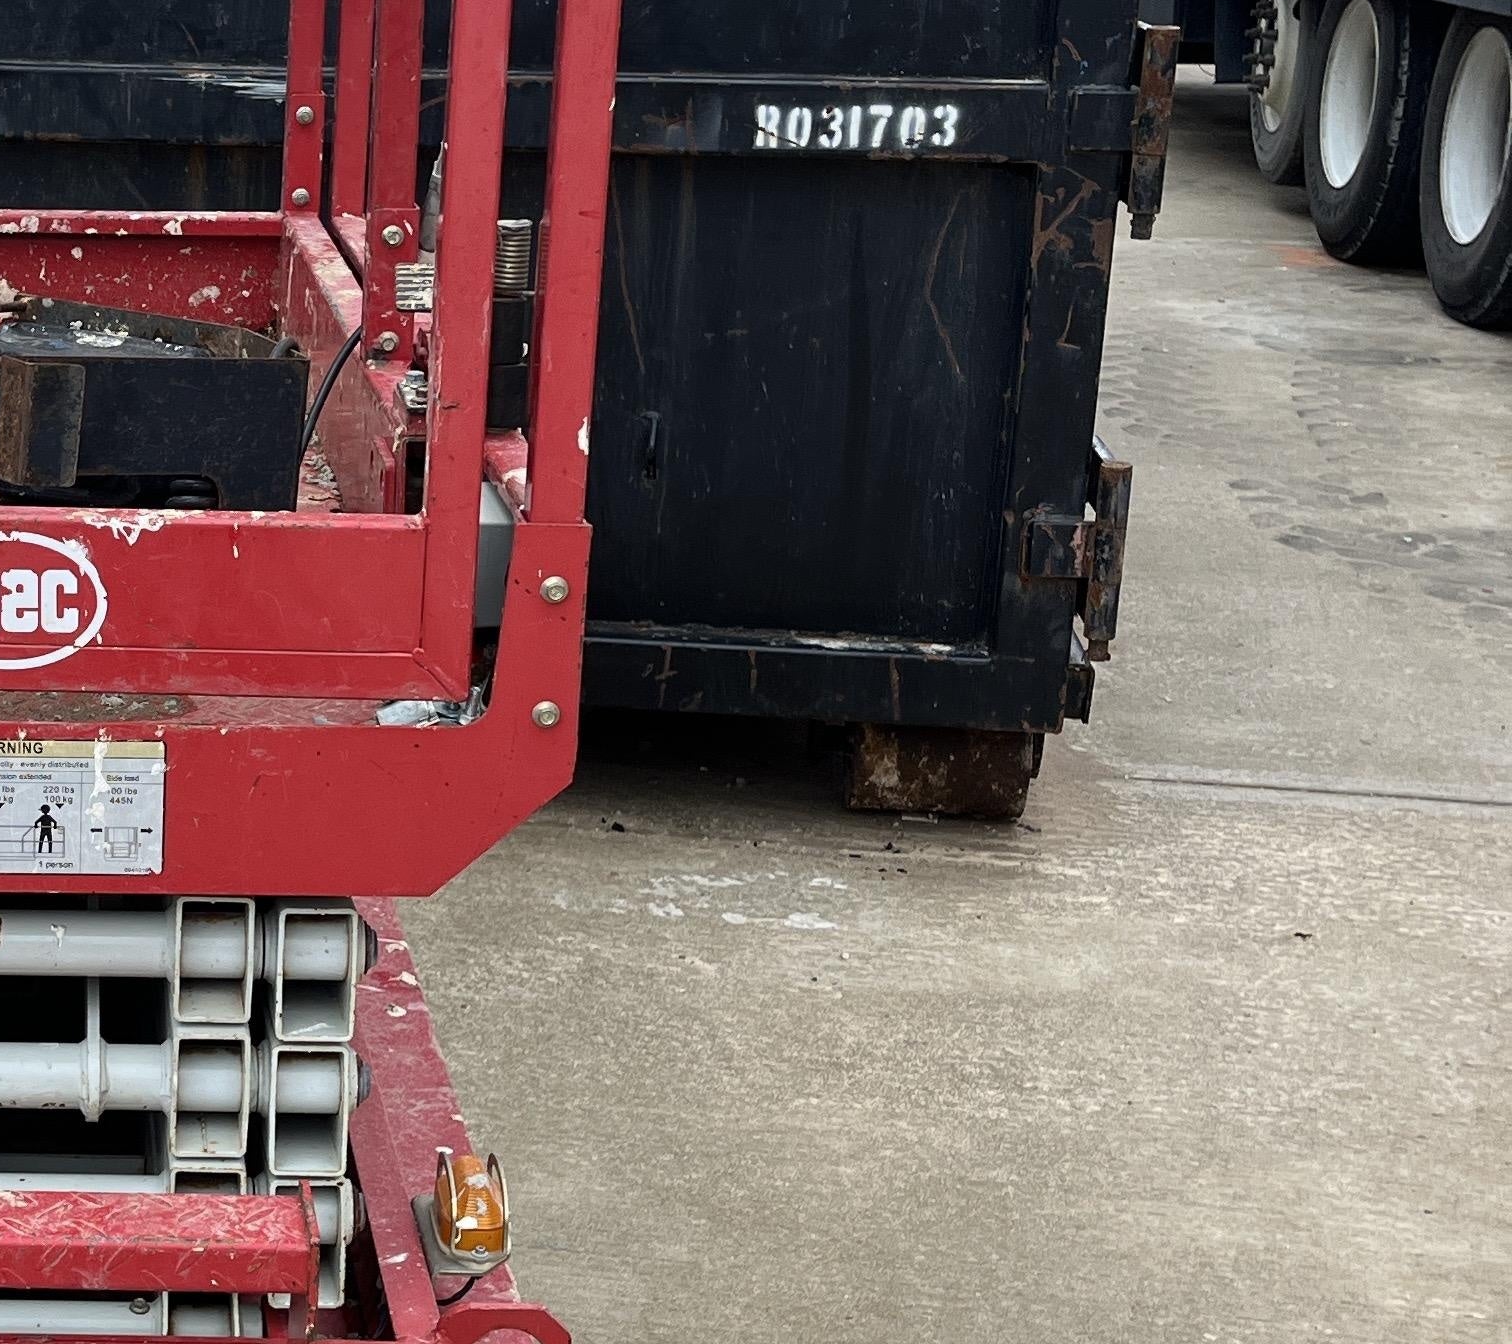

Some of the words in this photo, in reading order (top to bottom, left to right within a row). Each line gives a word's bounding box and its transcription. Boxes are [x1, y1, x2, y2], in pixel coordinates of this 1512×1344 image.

[20, 762, 46, 770] evenly
[47, 760, 89, 769] distributed
[1, 785, 16, 793] lbs
[42, 786, 60, 794] 220
[61, 786, 75, 794] lbs
[3, 795, 14, 804] kg
[62, 796, 73, 804] kg
